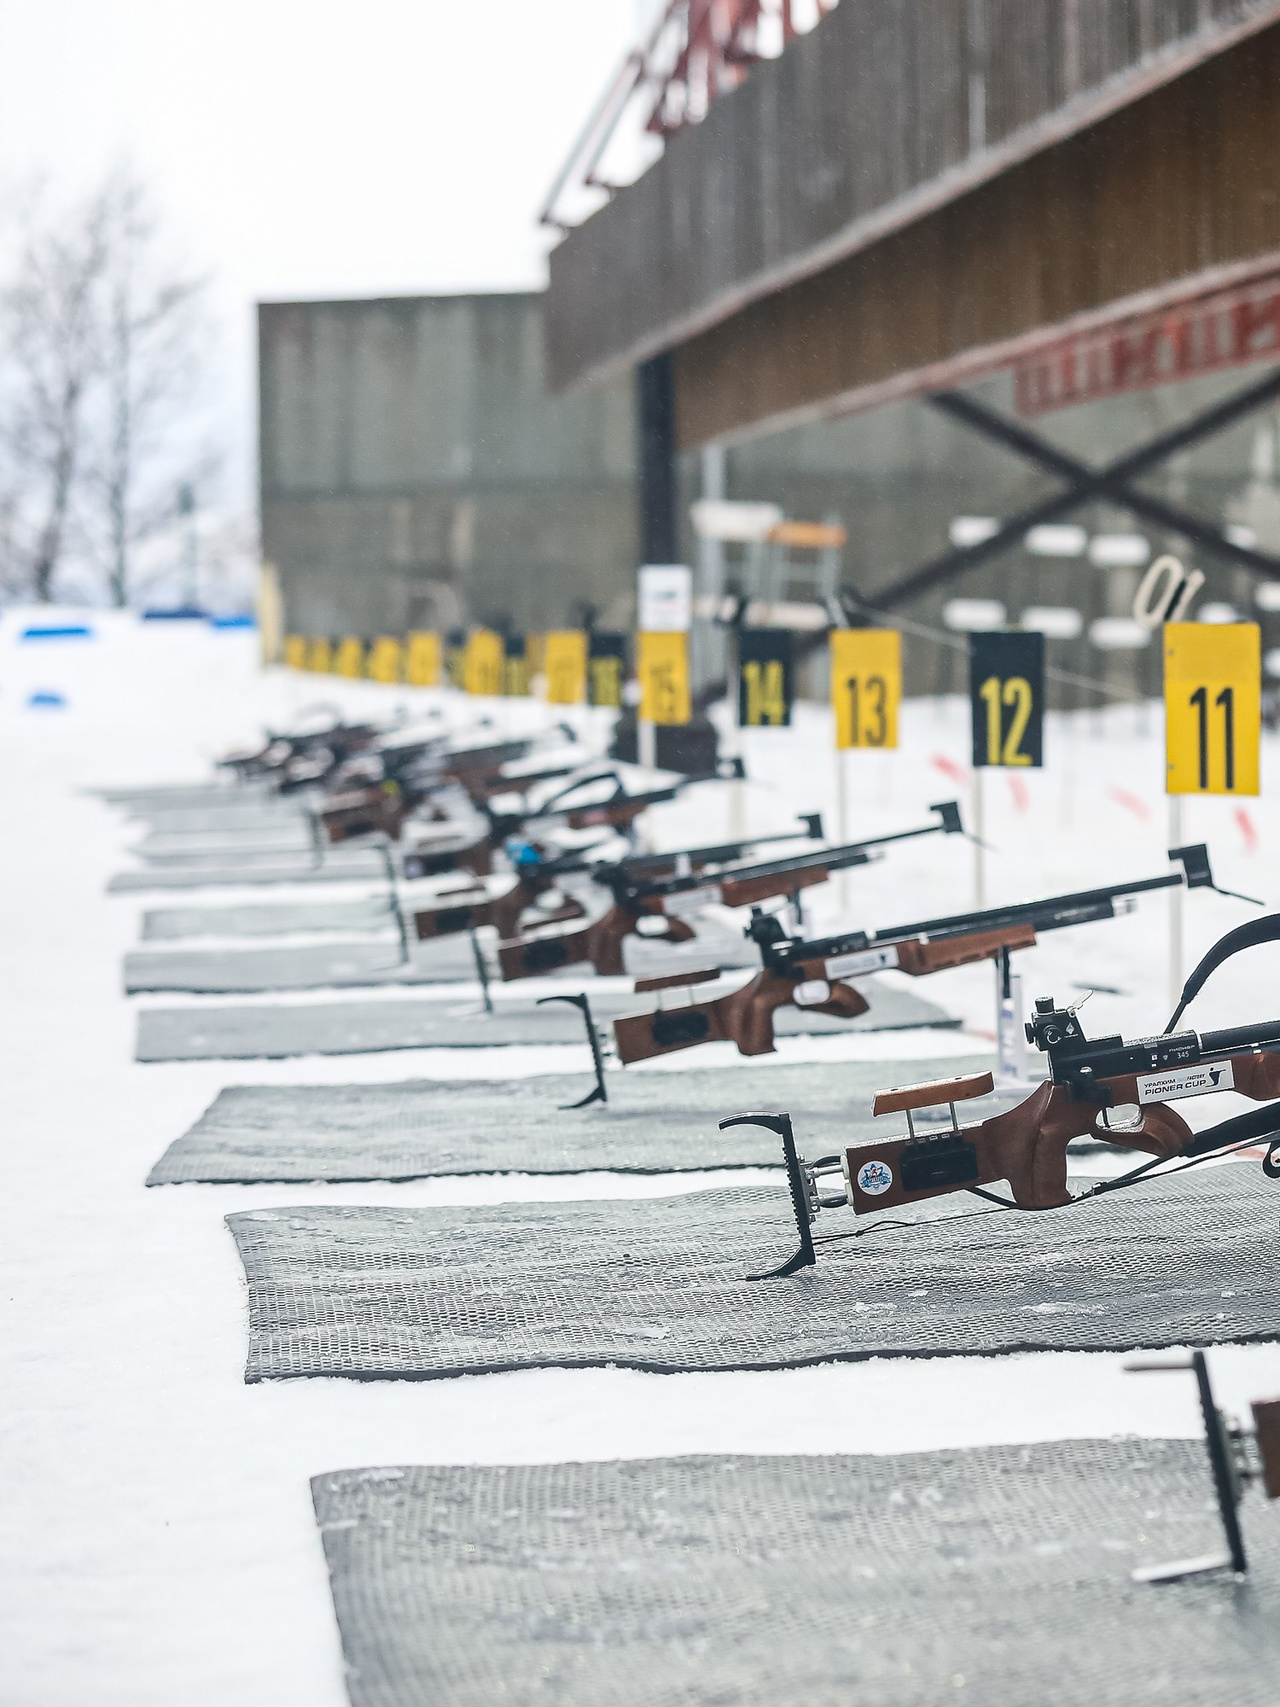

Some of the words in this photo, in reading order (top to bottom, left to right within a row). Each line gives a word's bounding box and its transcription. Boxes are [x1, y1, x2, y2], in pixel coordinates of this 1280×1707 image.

[648, 660, 676, 714] 15
[744, 660, 784, 725] 14
[845, 677, 888, 747] 13
[979, 676, 1033, 766] 12
[1189, 686, 1236, 790] 11
[1145, 1084, 1183, 1095] PIONER
[1185, 1080, 1206, 1089] CUP
[1177, 1051, 1190, 1059] 345
